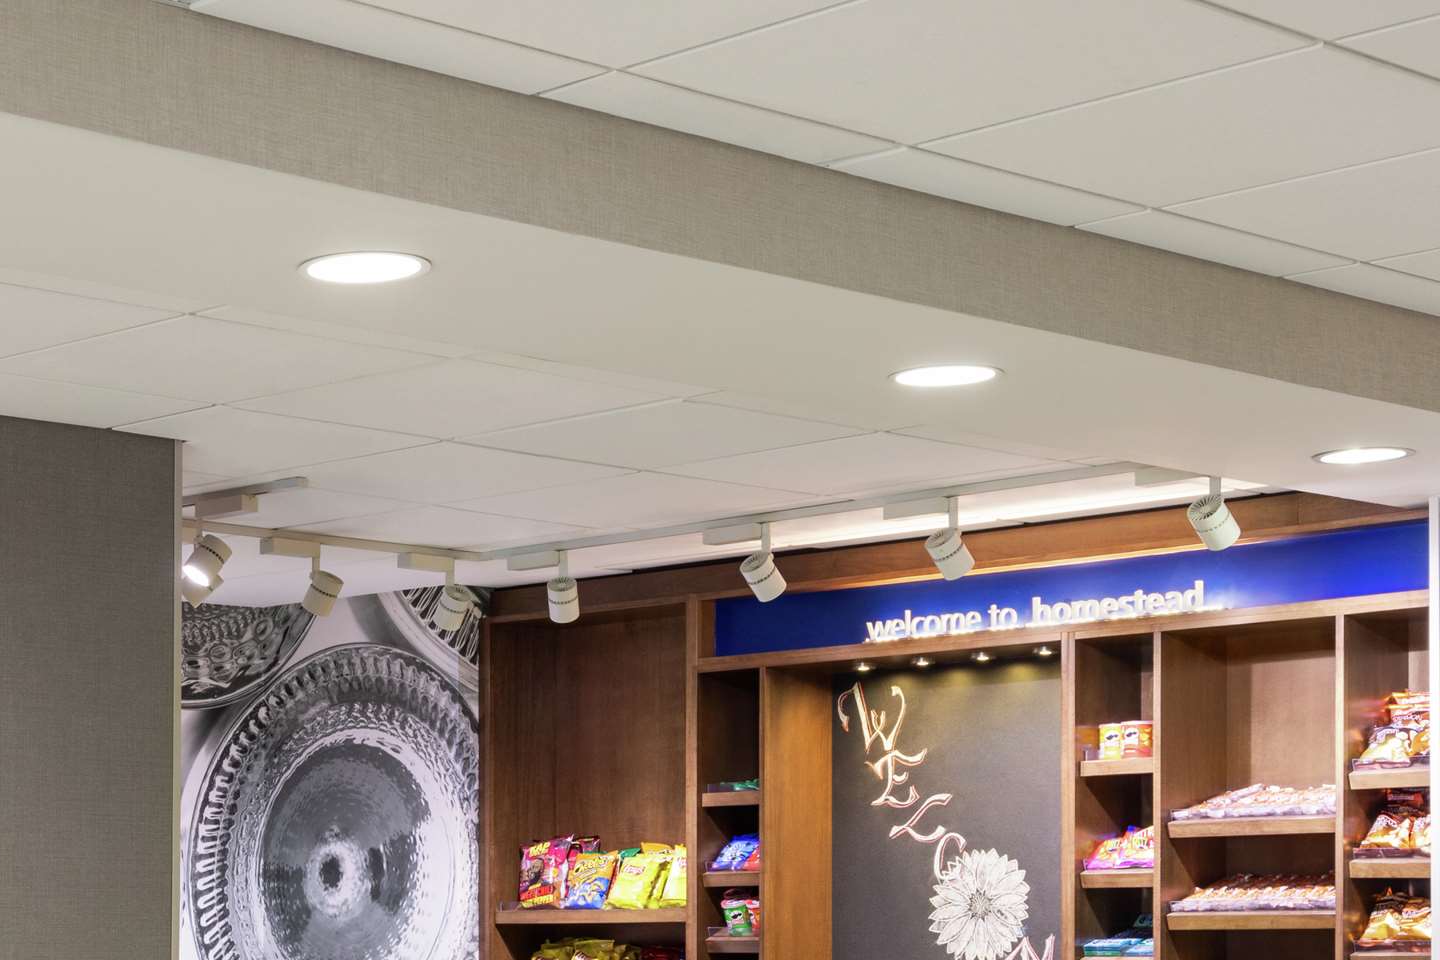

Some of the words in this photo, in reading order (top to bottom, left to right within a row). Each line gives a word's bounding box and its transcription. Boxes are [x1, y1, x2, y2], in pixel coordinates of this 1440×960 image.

[865, 609, 982, 641] welcome
[988, 604, 1018, 628] to
[1032, 580, 1205, 624] homestead
